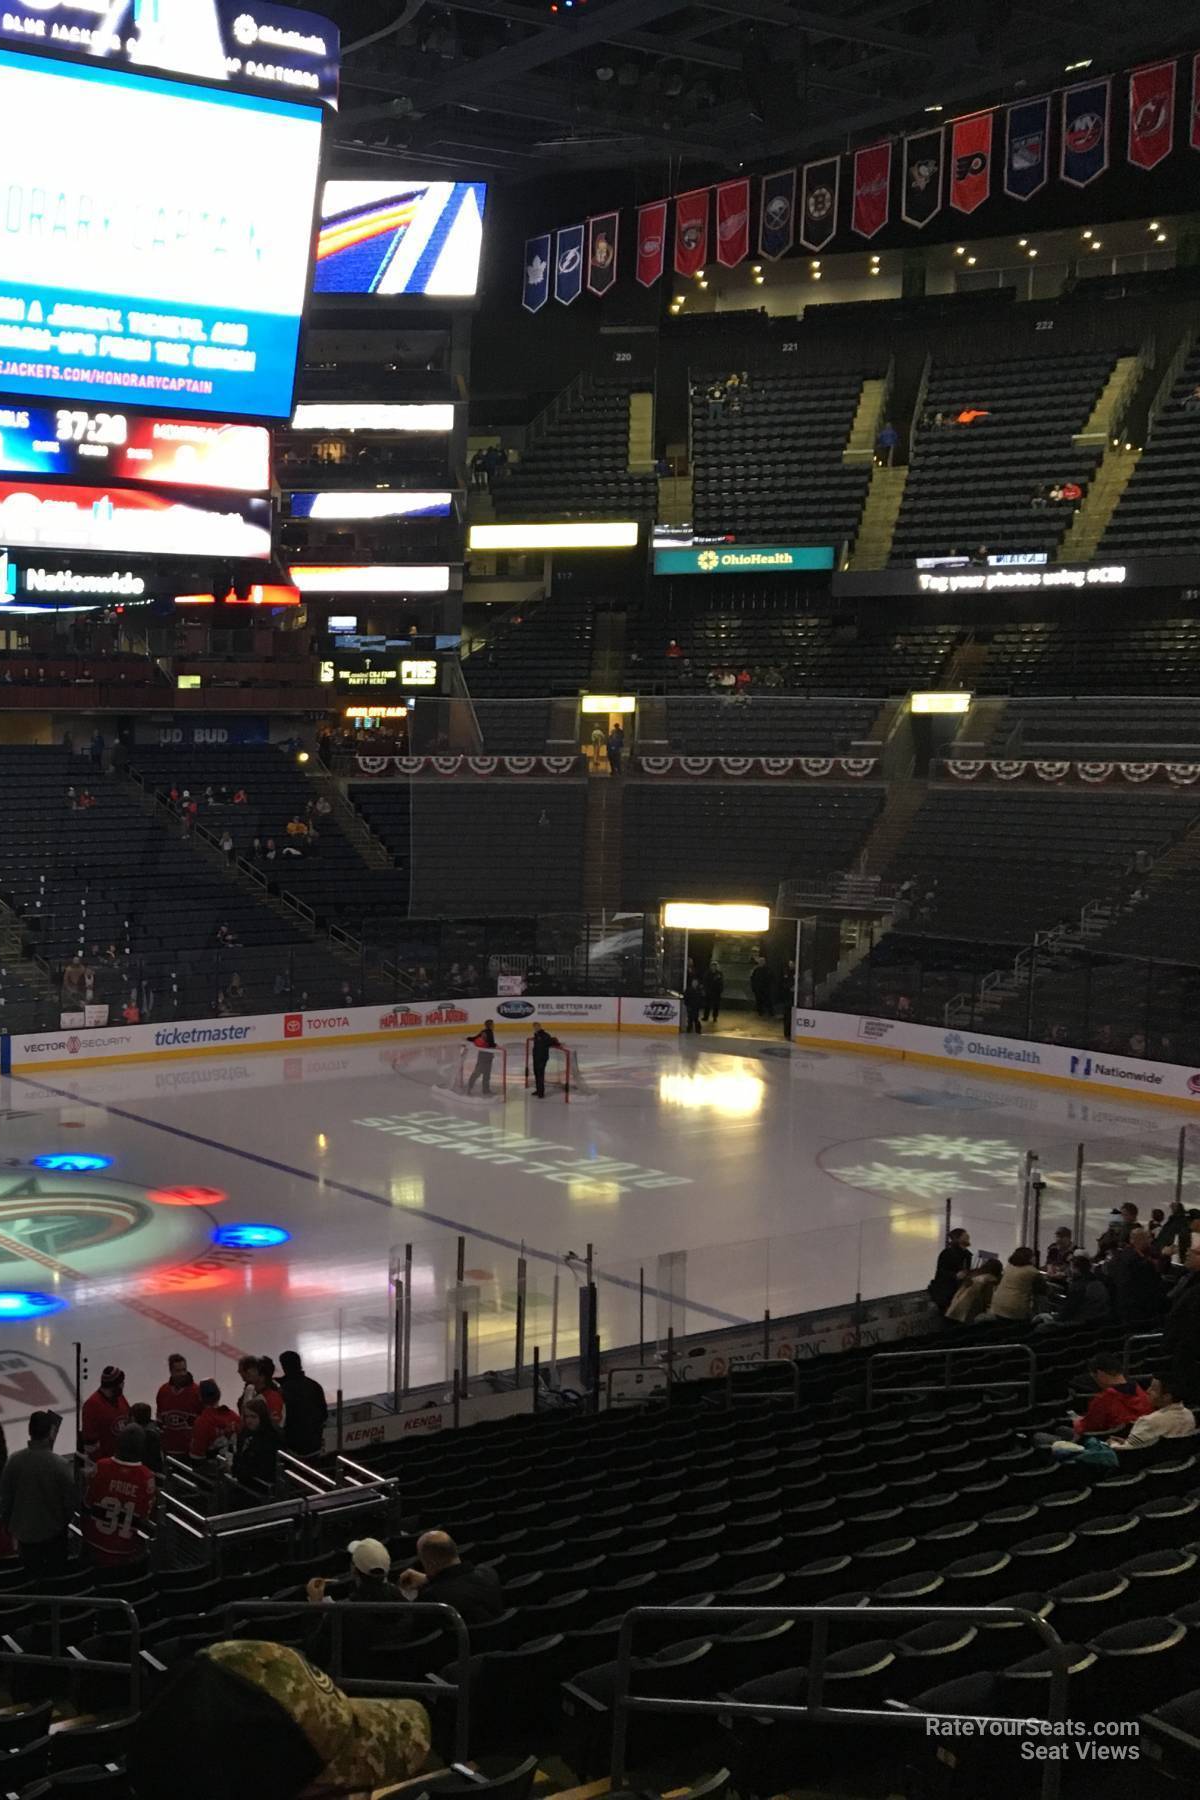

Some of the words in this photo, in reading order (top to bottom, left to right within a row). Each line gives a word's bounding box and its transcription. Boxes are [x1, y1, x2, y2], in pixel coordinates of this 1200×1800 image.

[1035, 320, 1054, 330] 222
[615, 352, 632, 362] 220
[720, 551, 794, 568] OhioHealth
[26, 568, 145, 595] Nationwide
[307, 1016, 350, 1029] TOYOTA
[154, 1024, 251, 1047] ticketmaster
[24, 1041, 66, 1054] VECTOR
[80, 1036, 132, 1049] SECURITY
[966, 1042, 1041, 1066] OhioHealth
[1094, 1063, 1162, 1085] Nationwide
[795, 1340, 827, 1359] PNC
[404, 1413, 443, 1430] KENDA
[345, 1425, 385, 1443] KENDA
[109, 1479, 139, 1497] PRICE
[95, 1497, 137, 1540] 31
